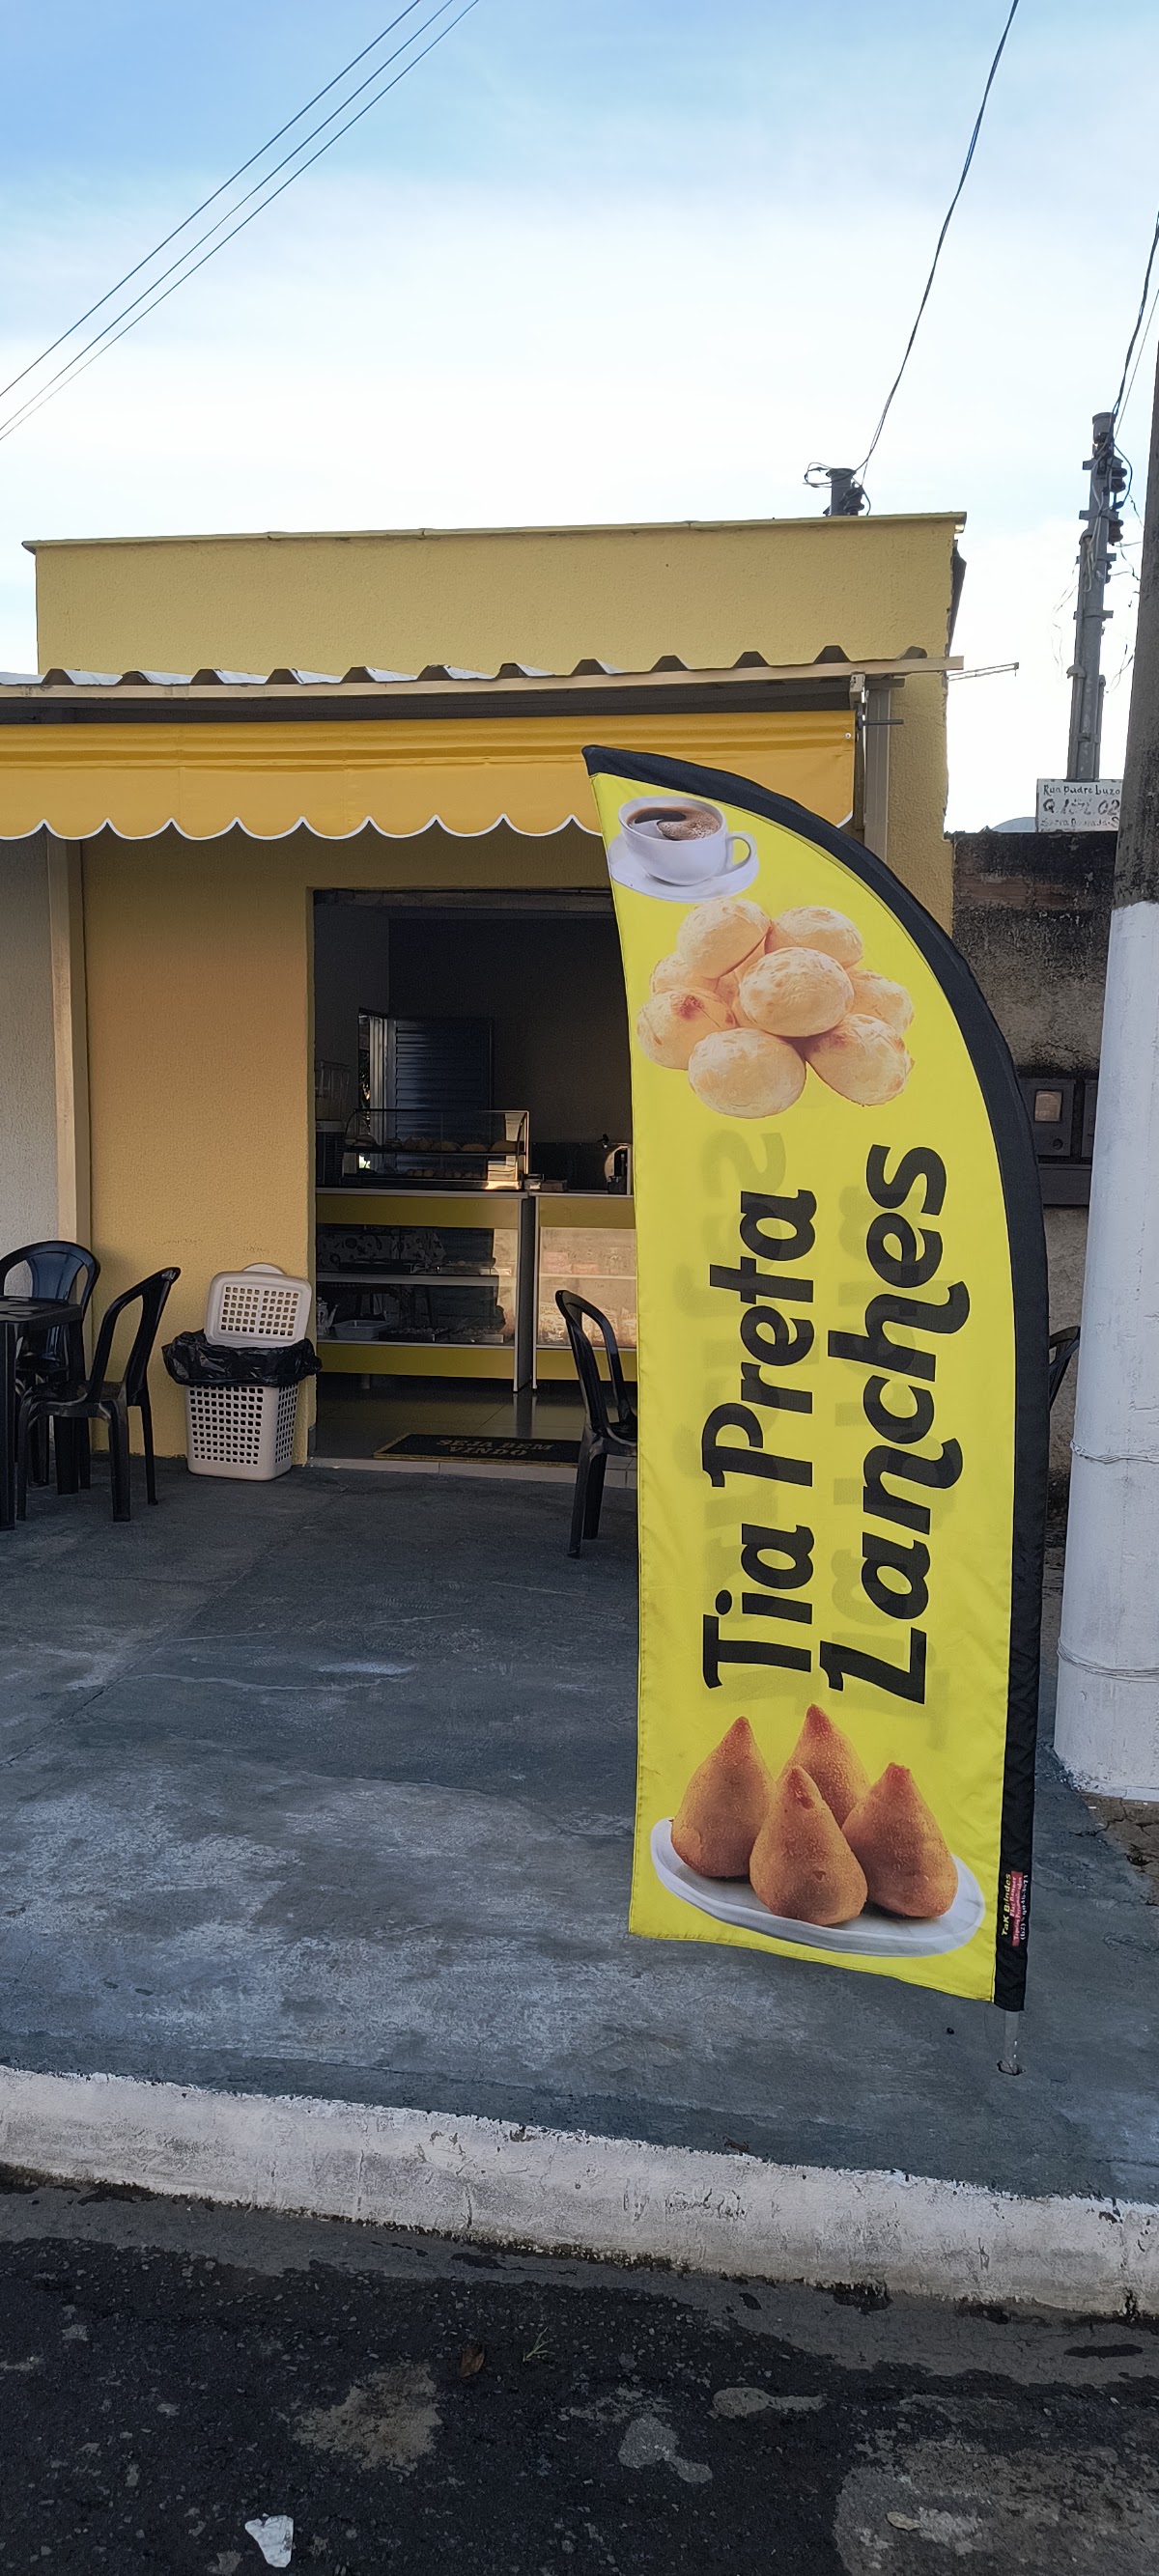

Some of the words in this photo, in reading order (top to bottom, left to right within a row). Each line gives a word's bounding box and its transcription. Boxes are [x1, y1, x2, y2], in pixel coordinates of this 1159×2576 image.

[702, 1189, 818, 1488] Preta
[436, 1439, 494, 1449] SEJA
[500, 1442, 555, 1451] BEM
[448, 1446, 528, 1456] VINDO
[819, 1143, 971, 1706] Lanches
[702, 1523, 815, 1689] Tia
